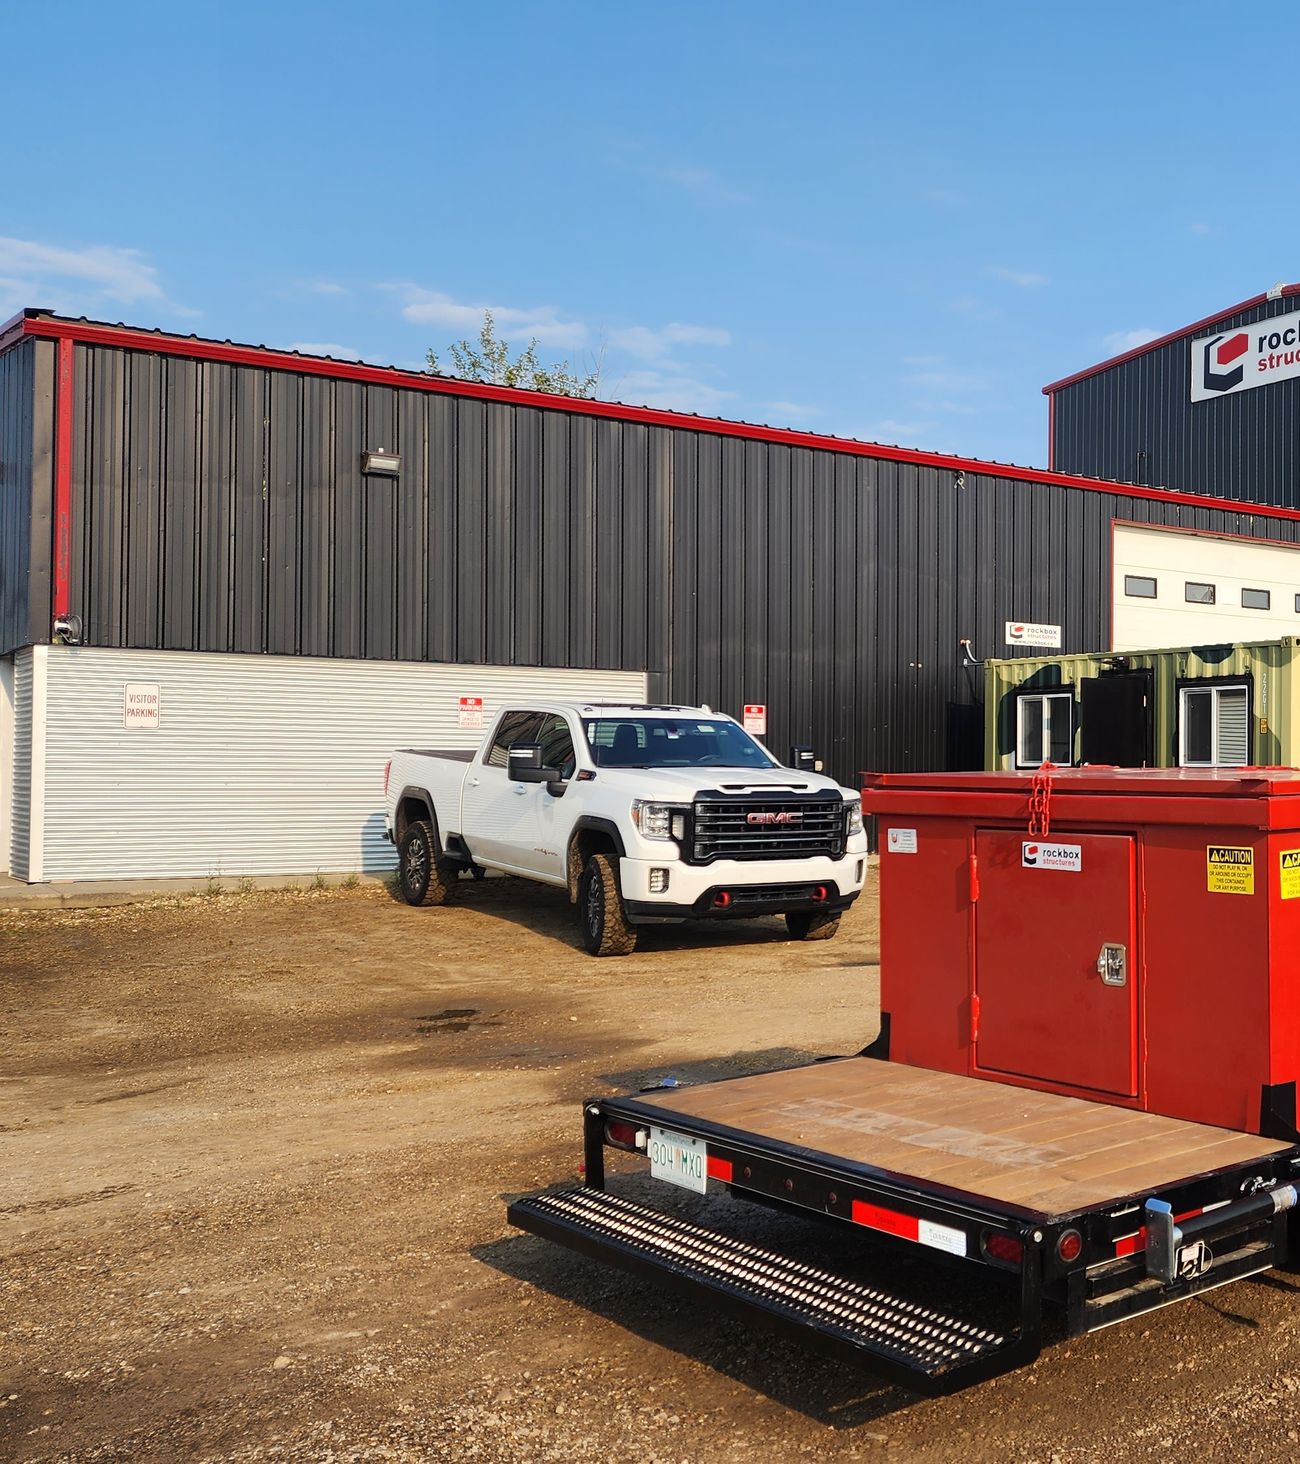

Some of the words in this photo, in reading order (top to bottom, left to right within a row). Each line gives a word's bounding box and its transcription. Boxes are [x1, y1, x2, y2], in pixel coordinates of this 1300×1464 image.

[130, 694, 157, 704] VISITOR
[127, 708, 158, 718] PARKING
[747, 812, 803, 824] GMC
[1043, 848, 1080, 859] rockbox
[1219, 850, 1251, 863] CAUTION
[1043, 858, 1076, 866] structures
[652, 1142, 673, 1170] 304
